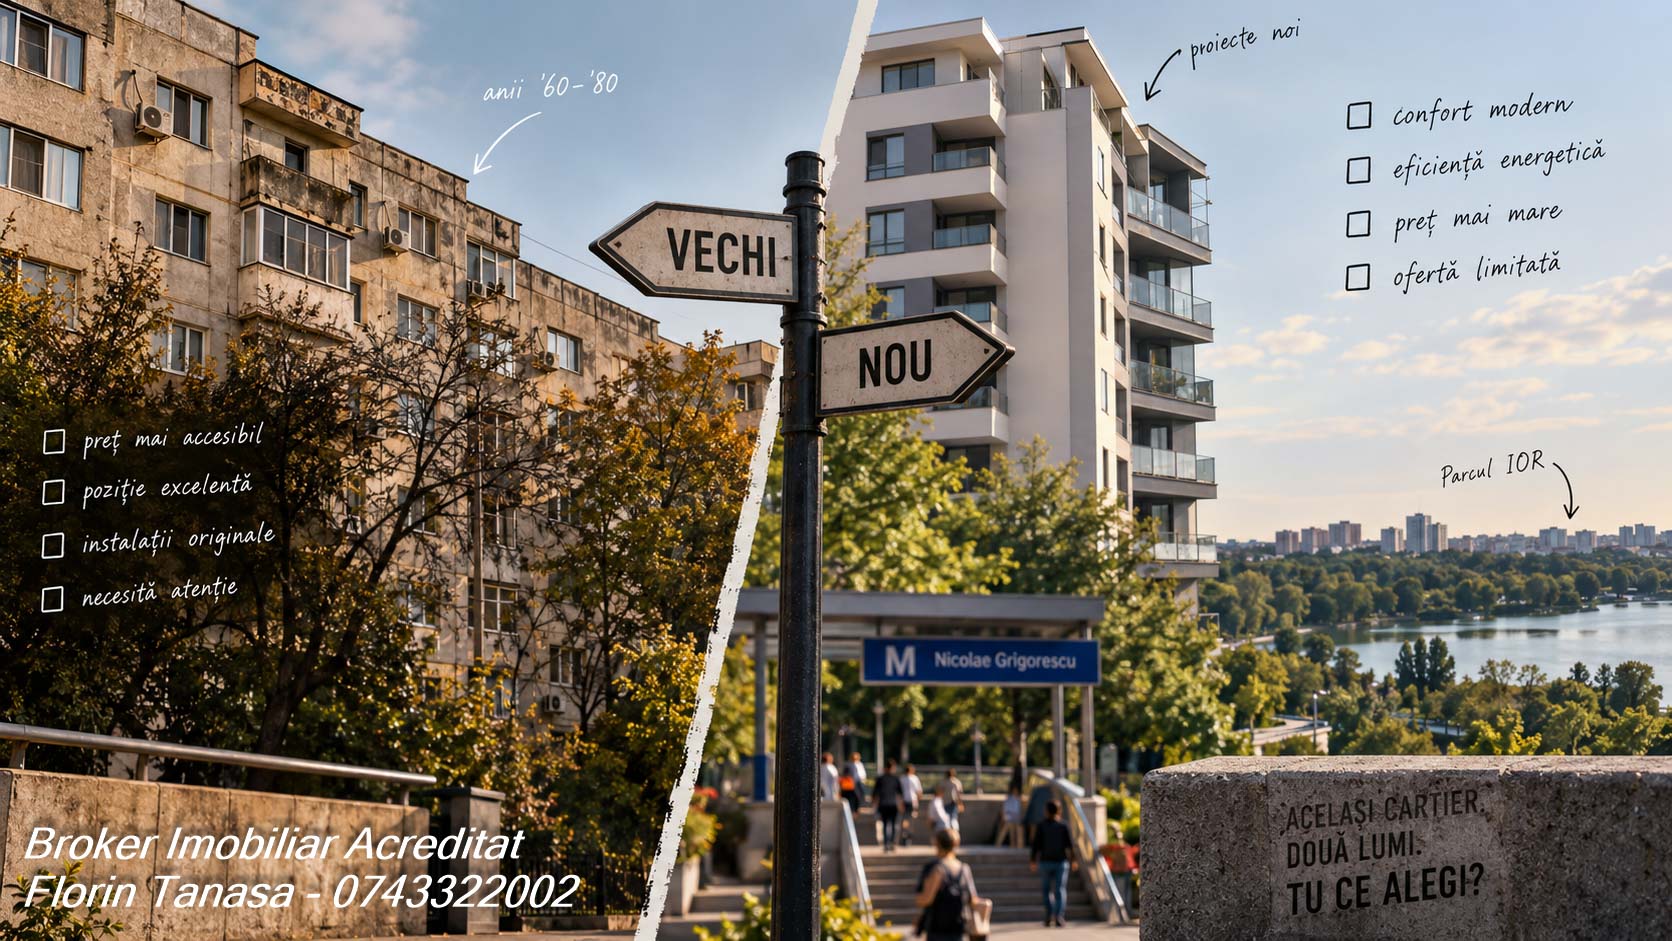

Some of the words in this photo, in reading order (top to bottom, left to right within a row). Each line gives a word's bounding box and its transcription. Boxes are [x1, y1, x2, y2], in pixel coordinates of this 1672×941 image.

[666, 227, 776, 278] VECHI
[859, 339, 932, 389] NOU
[884, 645, 916, 676] M
[934, 651, 992, 668] Nicolae
[994, 652, 1076, 672] Grigorescu
[1286, 799, 1374, 831] ACELAȘI
[1287, 831, 1349, 869] DOUĂ
[1359, 830, 1422, 862] LUMI.
[1286, 880, 1322, 916] TU
[1336, 875, 1371, 910] CE
[1382, 862, 1485, 905] ALEGI?
